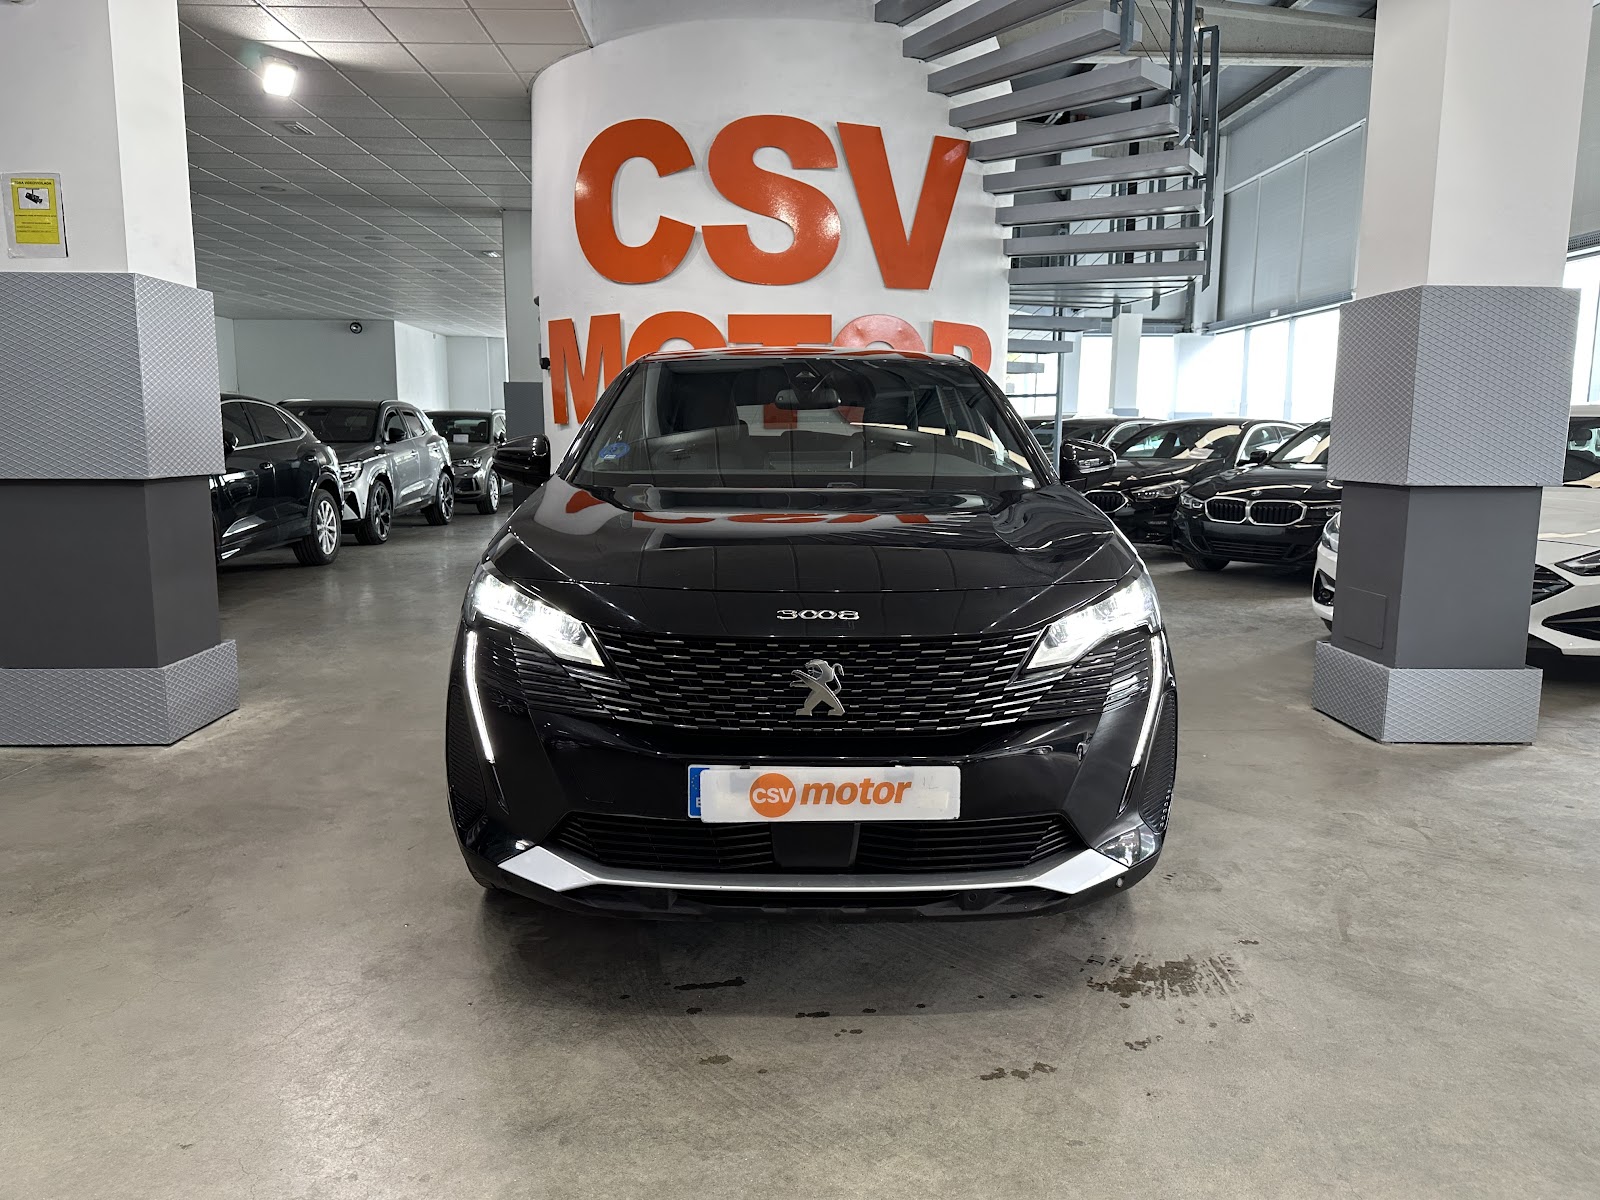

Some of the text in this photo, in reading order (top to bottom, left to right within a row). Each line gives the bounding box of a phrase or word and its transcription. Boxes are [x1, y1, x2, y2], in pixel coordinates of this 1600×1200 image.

[574, 114, 971, 290] CSV
[776, 609, 860, 620] 3008
[752, 778, 912, 805] CSV motor
